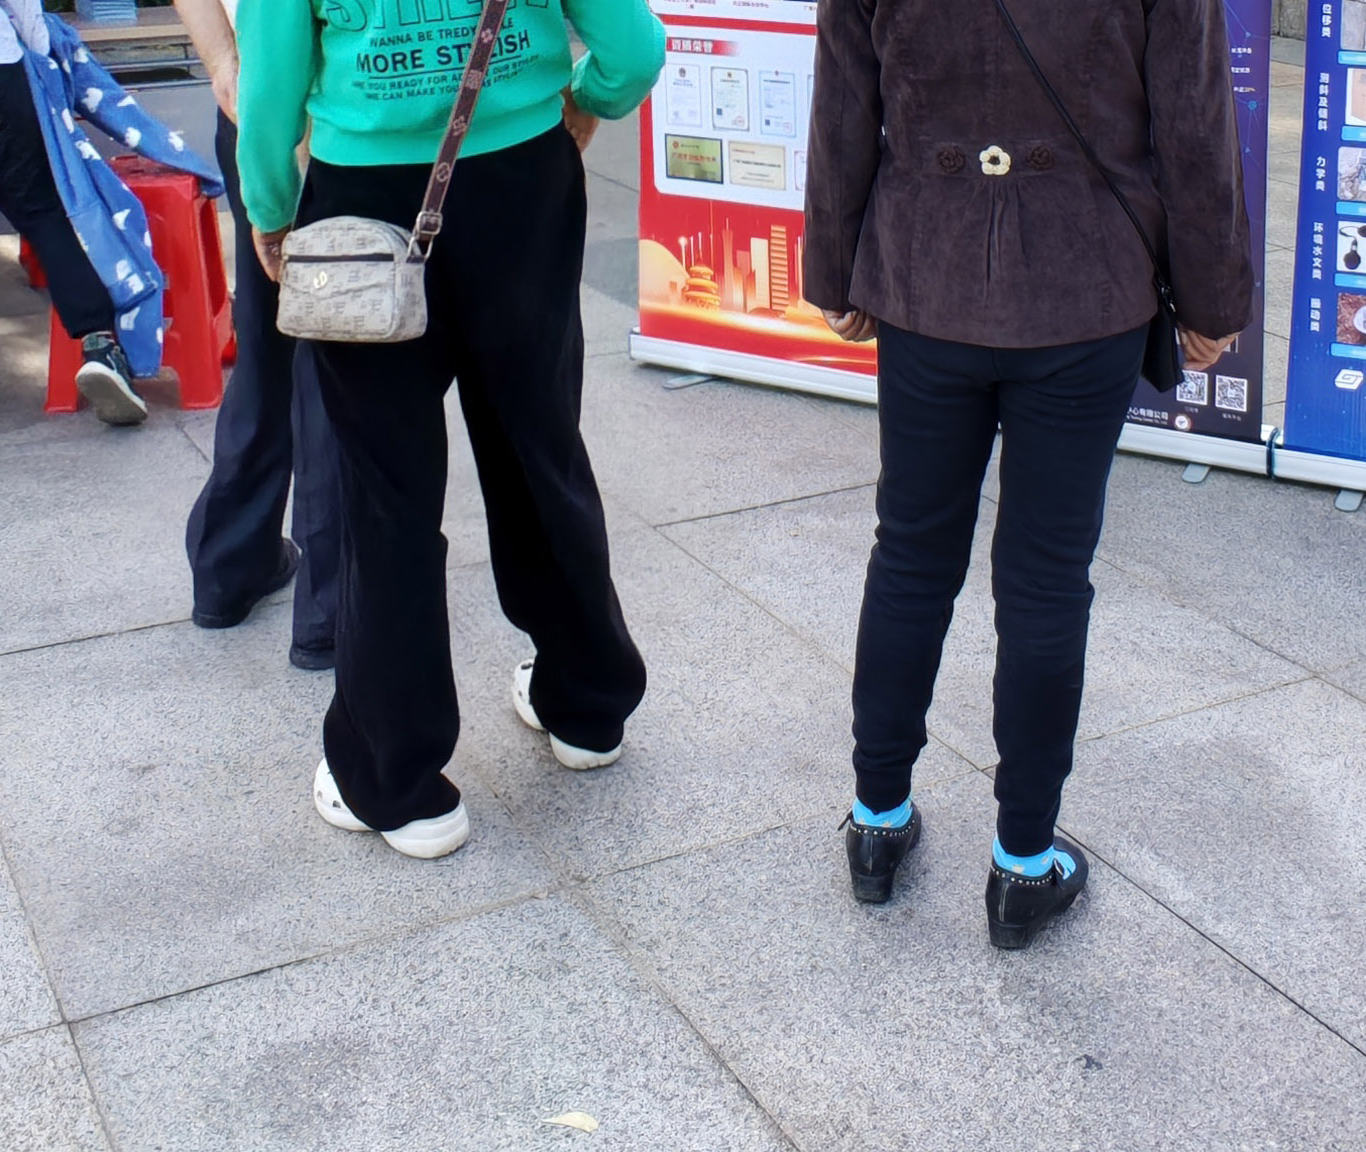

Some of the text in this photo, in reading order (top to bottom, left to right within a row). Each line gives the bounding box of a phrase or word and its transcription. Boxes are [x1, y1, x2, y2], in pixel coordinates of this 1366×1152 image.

[370, 32, 413, 47] WANNA
[417, 31, 434, 43] BE
[356, 29, 531, 74] MORE STISH
[389, 77, 423, 90] READY
[427, 75, 448, 85] FOR
[381, 89, 404, 100] CAN
[406, 86, 435, 98] MAKE
